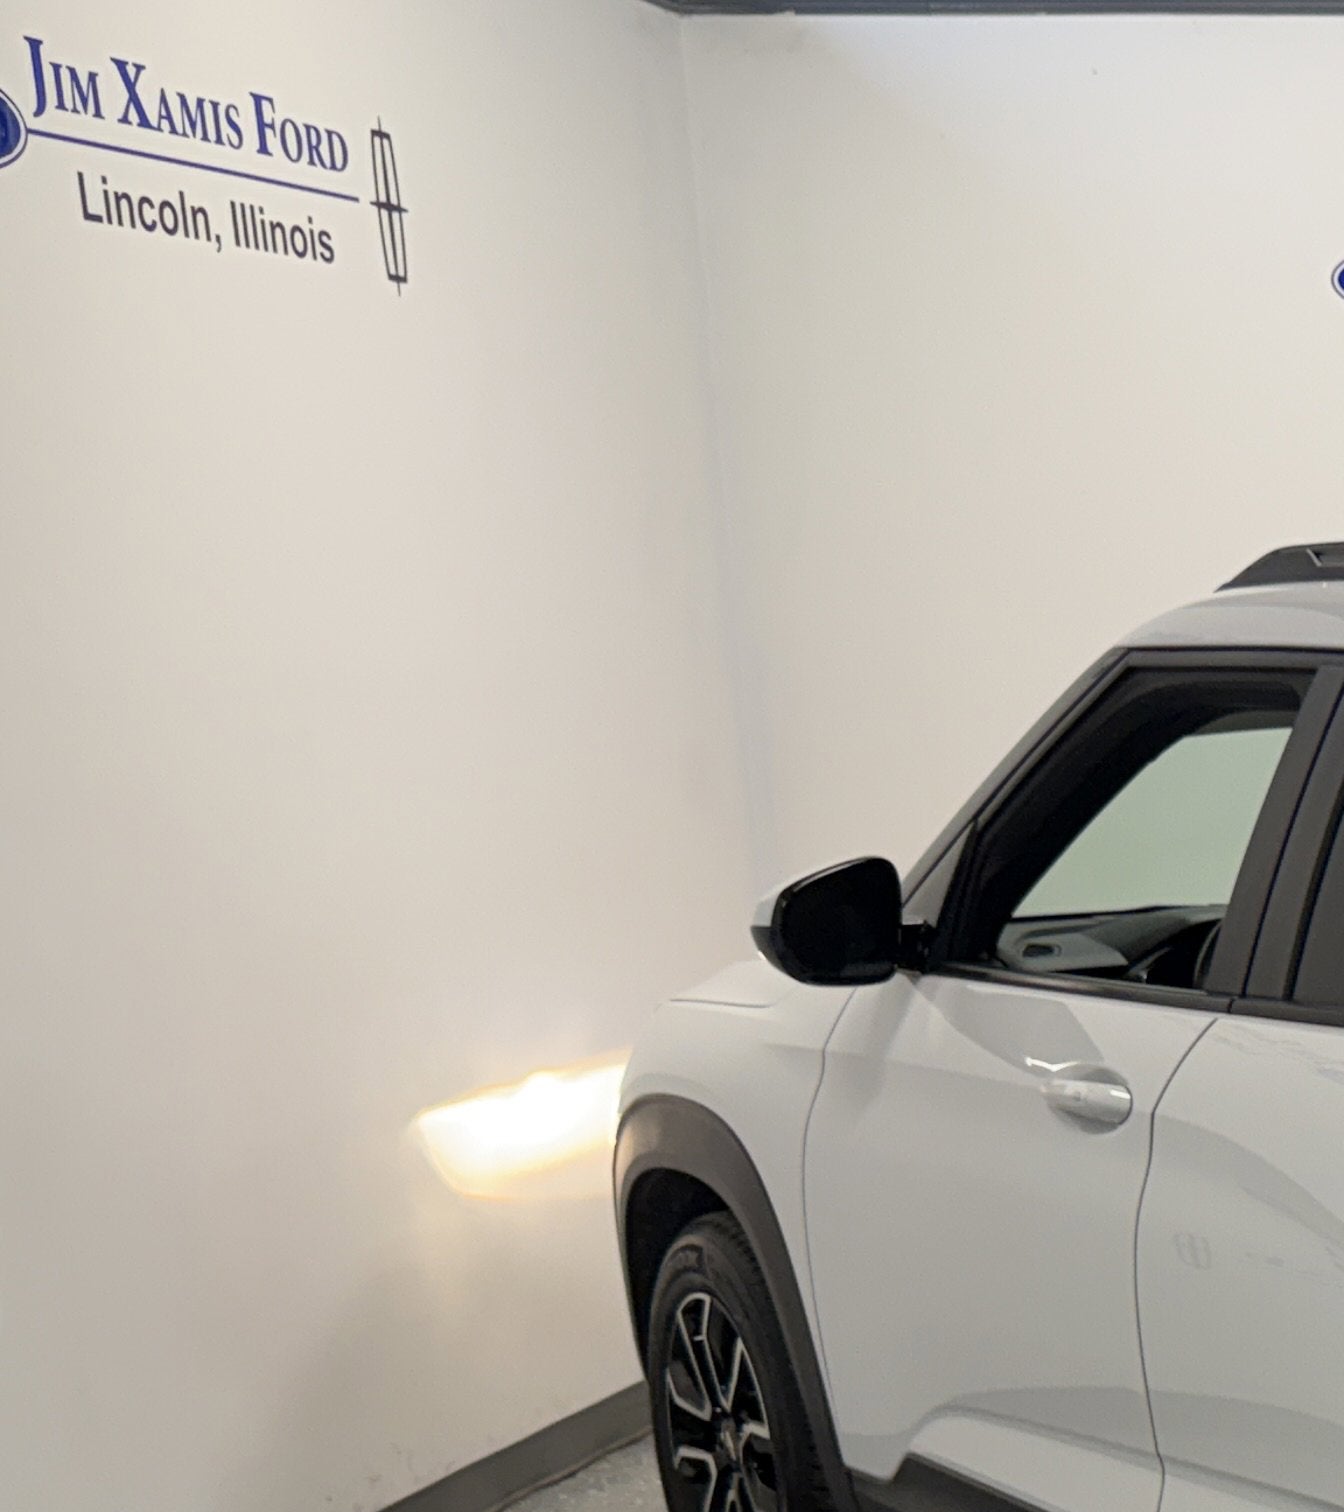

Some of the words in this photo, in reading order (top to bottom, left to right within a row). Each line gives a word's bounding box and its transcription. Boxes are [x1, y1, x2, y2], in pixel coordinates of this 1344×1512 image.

[23, 36, 105, 120] JIM
[110, 57, 244, 149] XAMIS
[249, 92, 349, 172] FORD
[77, 172, 222, 253] Lincoln,
[230, 200, 335, 264] Illinois
